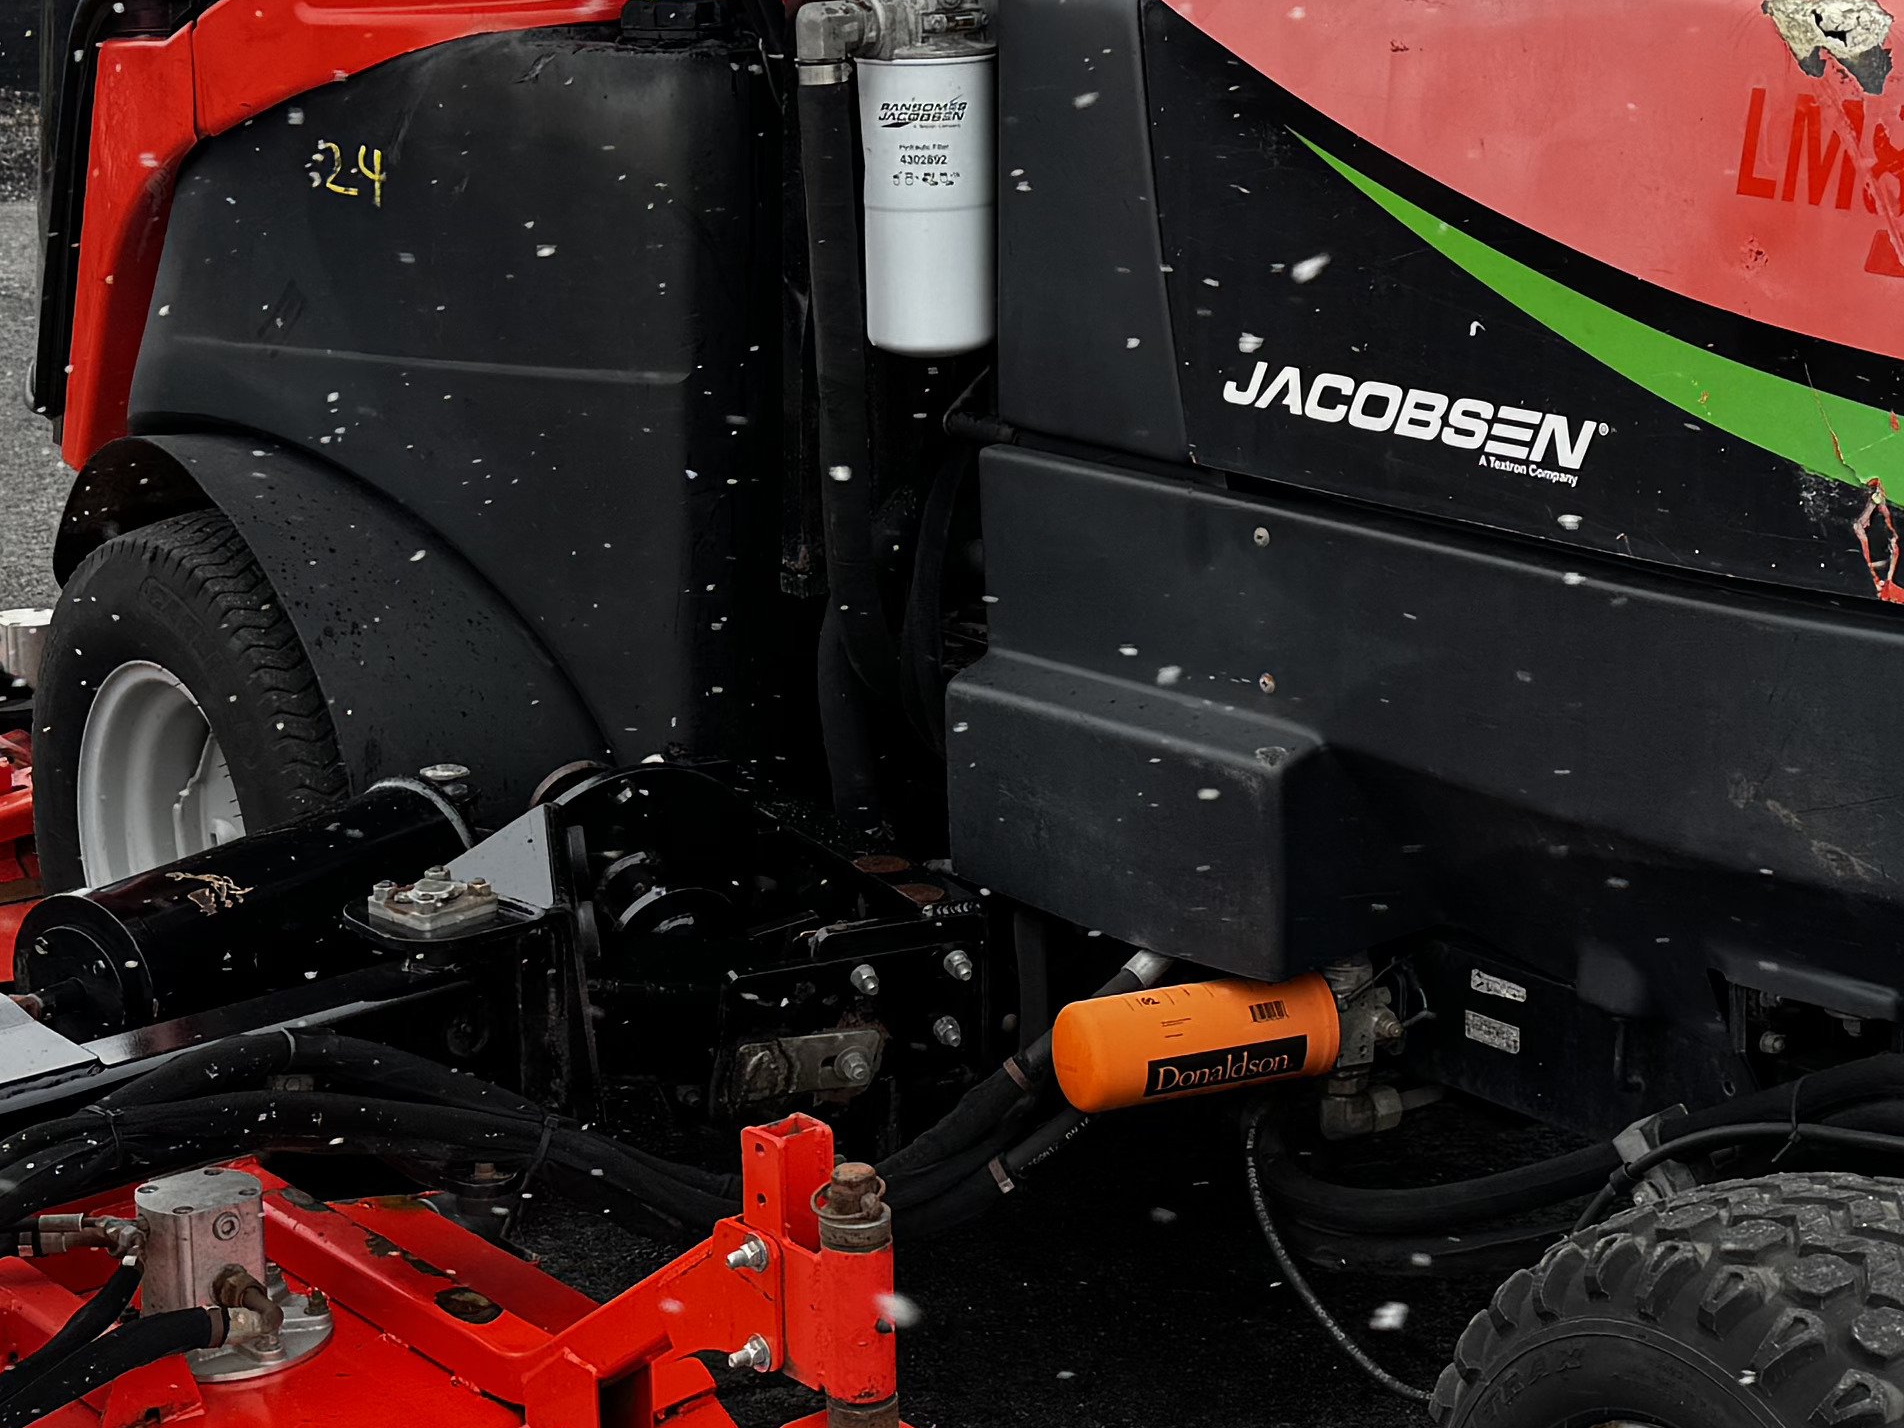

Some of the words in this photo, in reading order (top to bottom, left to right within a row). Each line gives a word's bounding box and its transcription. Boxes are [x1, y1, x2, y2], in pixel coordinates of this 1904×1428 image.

[878, 112, 965, 122] JACOBSEN
[880, 101, 968, 112] RANSOMES
[318, 141, 385, 207] 24
[1222, 361, 1597, 470] JACOBSEN
[1478, 454, 1487, 467] A
[1489, 456, 1527, 475] Textron
[1528, 464, 1578, 488] Company
